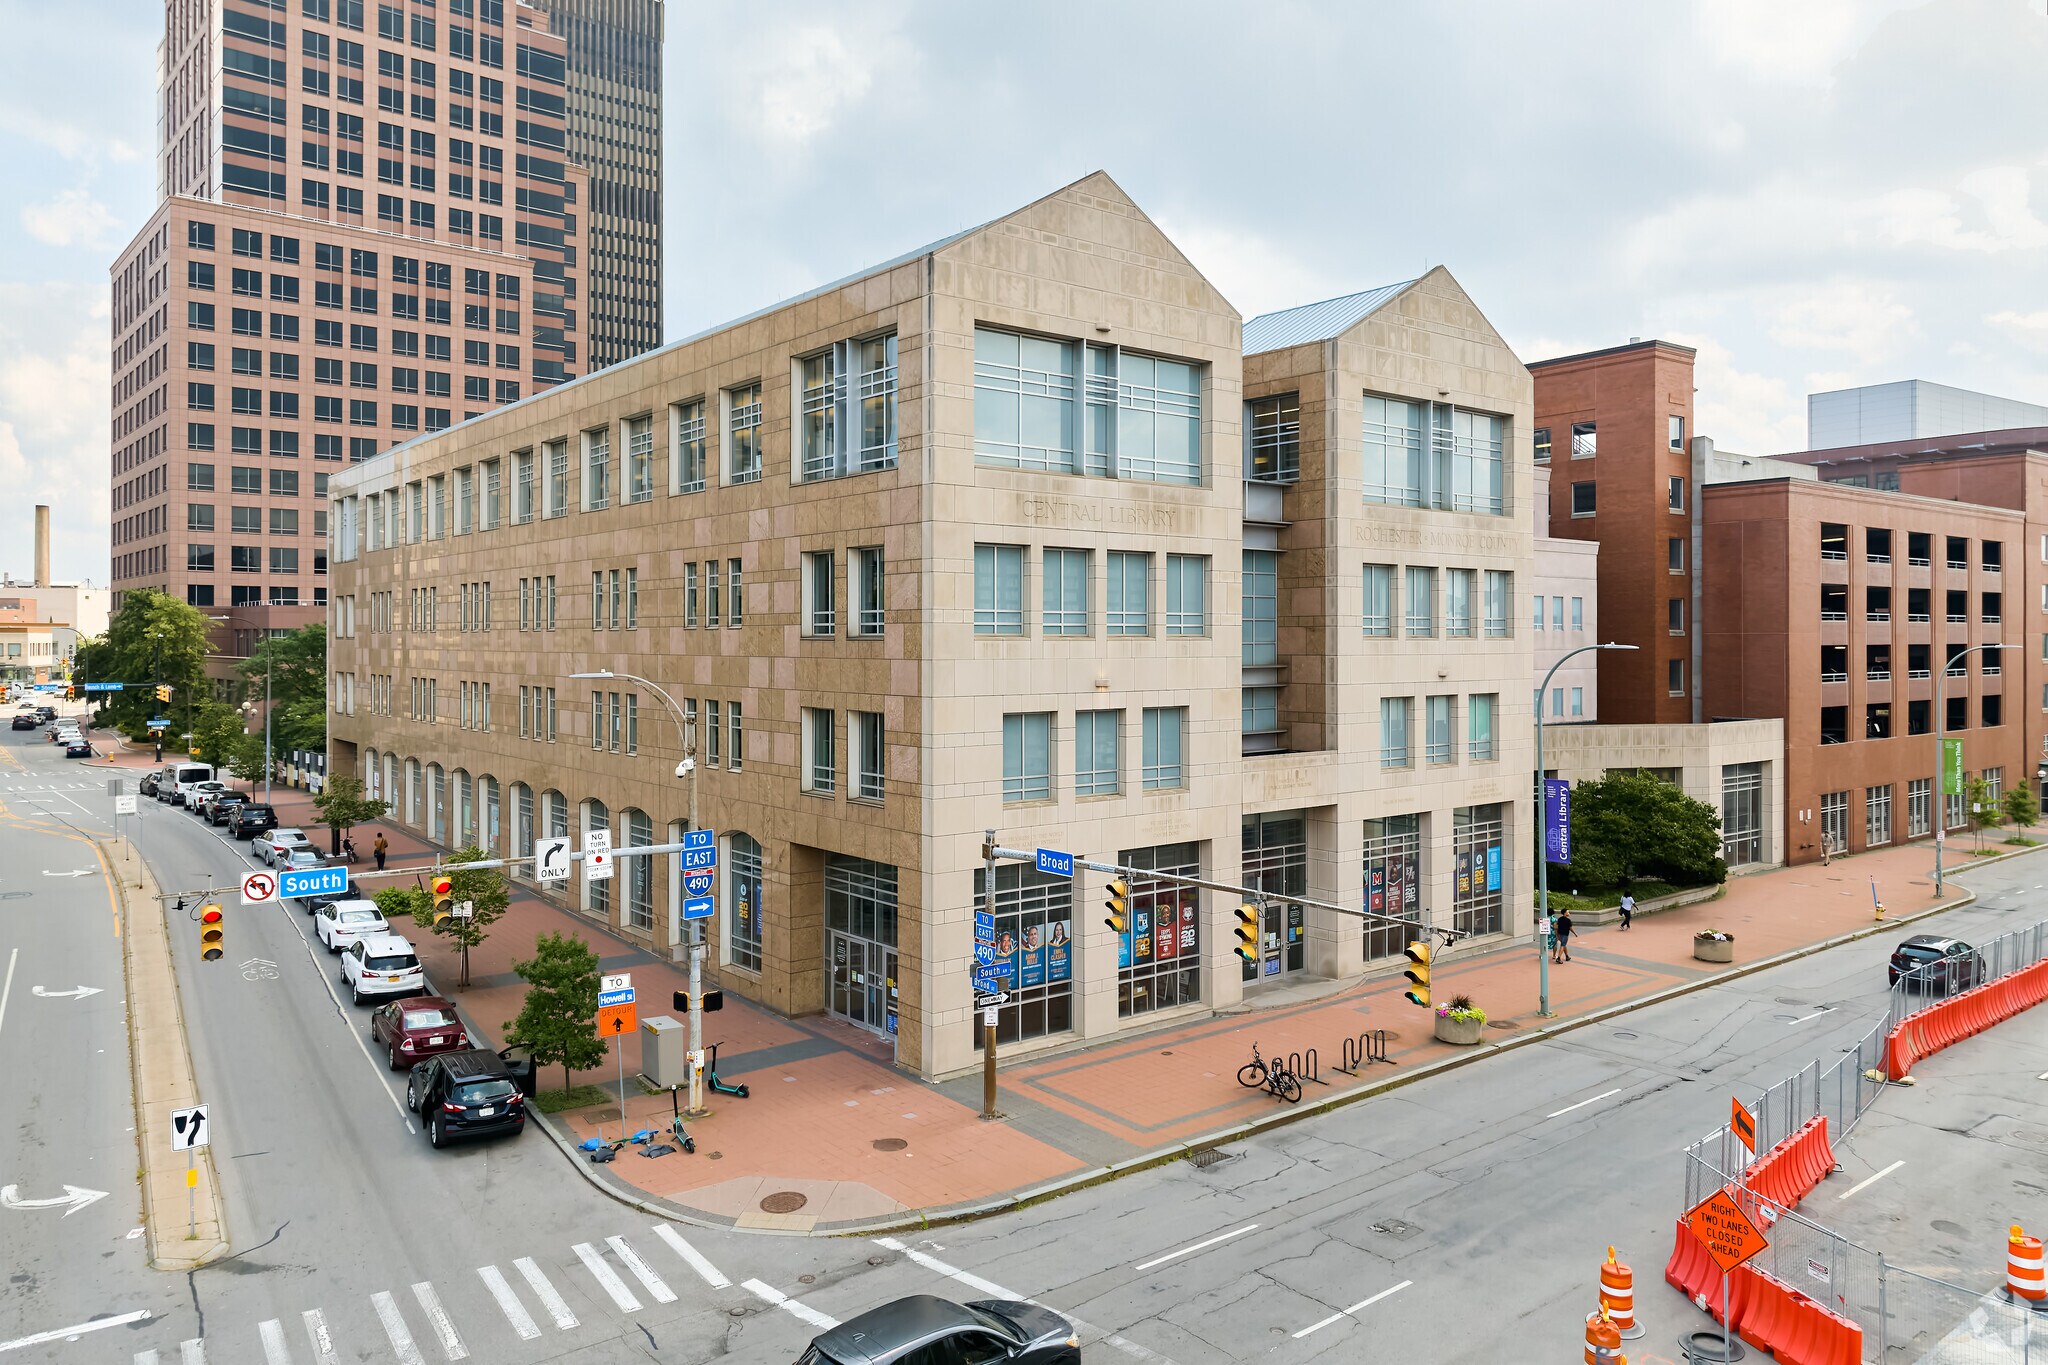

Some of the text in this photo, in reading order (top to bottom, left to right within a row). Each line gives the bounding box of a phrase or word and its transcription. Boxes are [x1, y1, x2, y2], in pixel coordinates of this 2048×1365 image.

[1023, 499, 1176, 528] CENTRAL LIBRARY
[1355, 526, 1520, 551] ROCHESTER MONROE COUNTY
[1559, 785, 1568, 860] Central Library
[592, 832, 603, 841] NO
[692, 834, 706, 845] TO
[686, 852, 711, 866] EAST
[1040, 853, 1069, 871] Broad
[541, 868, 566, 877] ONLY
[286, 873, 341, 892] South
[689, 877, 708, 890] 490
[1405, 887, 1415, 895] 20
[1405, 894, 1416, 903] 25
[739, 902, 748, 910] 20
[739, 910, 748, 919] 25
[982, 915, 988, 924] TO
[978, 930, 992, 938] EAST
[1181, 929, 1195, 939] 20
[1181, 938, 1195, 948] 25
[977, 945, 993, 961] 490
[980, 966, 1000, 977] South
[609, 978, 622, 987] TO
[974, 976, 989, 990] Broad
[600, 992, 626, 1004] Howell
[601, 1006, 632, 1017] DETOUR
[1711, 1203, 1735, 1217] RIGHT
[1701, 1212, 1749, 1235] TWO LANES
[1706, 1227, 1743, 1246] CLOSED
[1711, 1241, 1740, 1258] AHEAD
